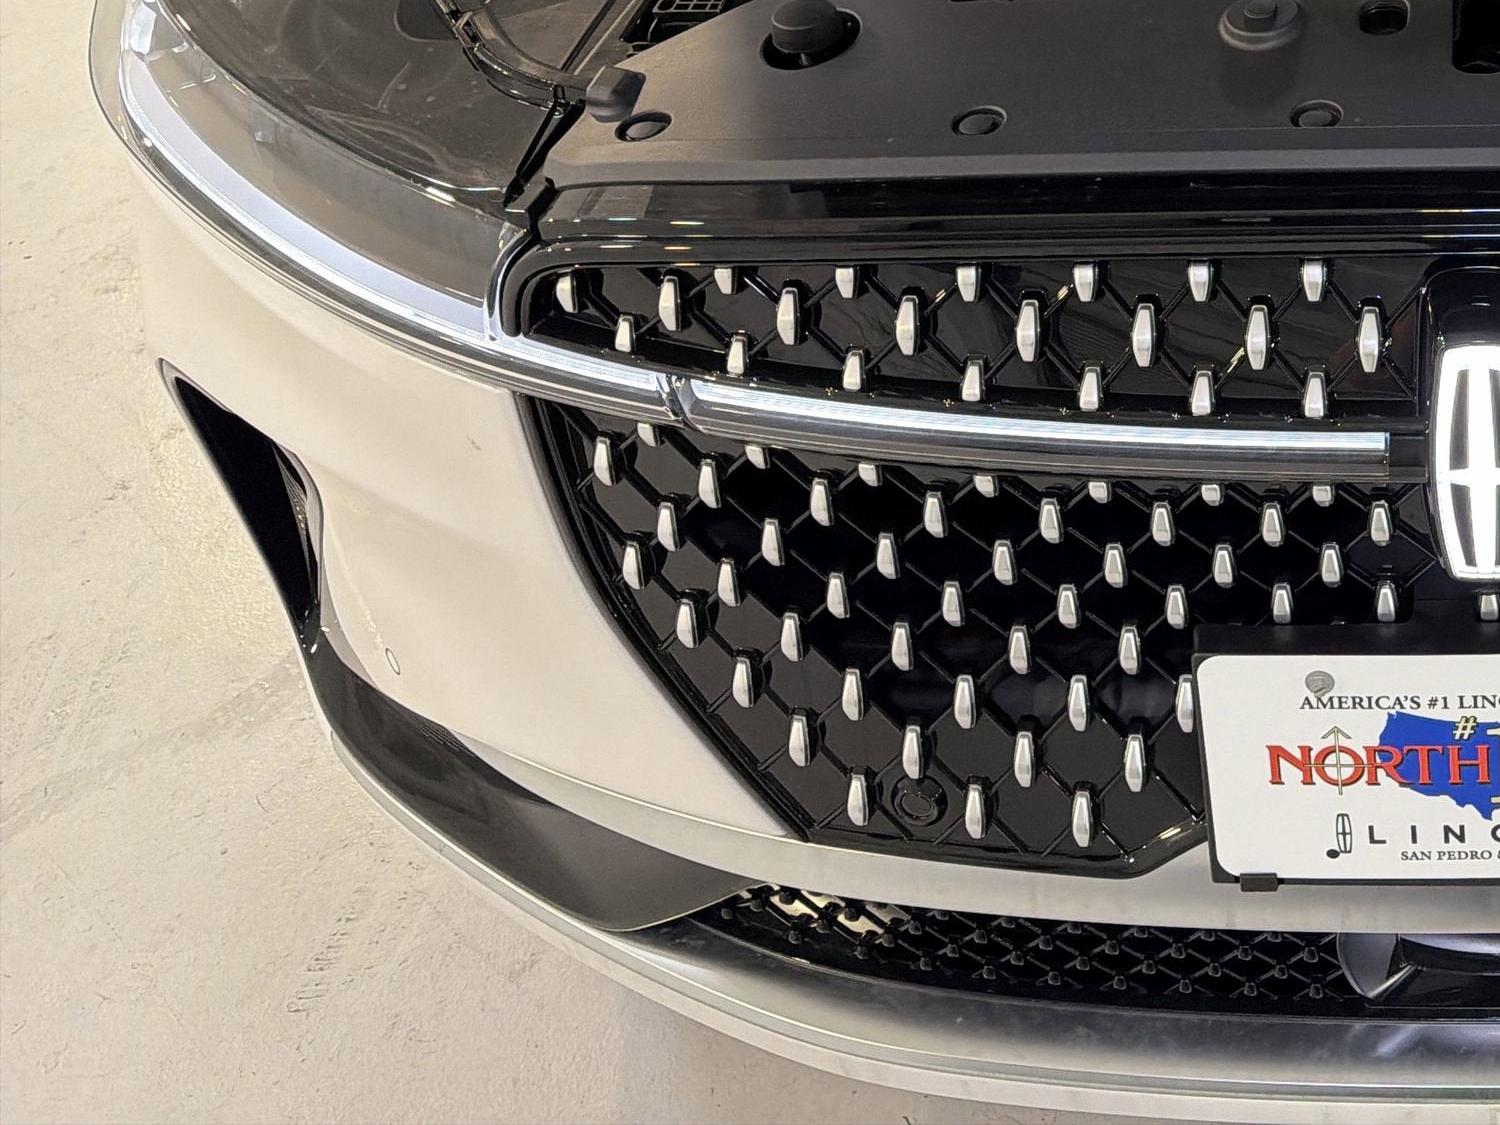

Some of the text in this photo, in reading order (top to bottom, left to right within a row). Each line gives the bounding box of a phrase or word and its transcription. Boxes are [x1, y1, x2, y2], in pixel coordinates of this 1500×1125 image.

[1299, 694, 1422, 711] AMERICA'S
[1427, 694, 1451, 710] #1
[1265, 743, 1491, 786] NORTH
[1400, 850, 1433, 861] SAN
[1436, 849, 1493, 861] PEDRO
